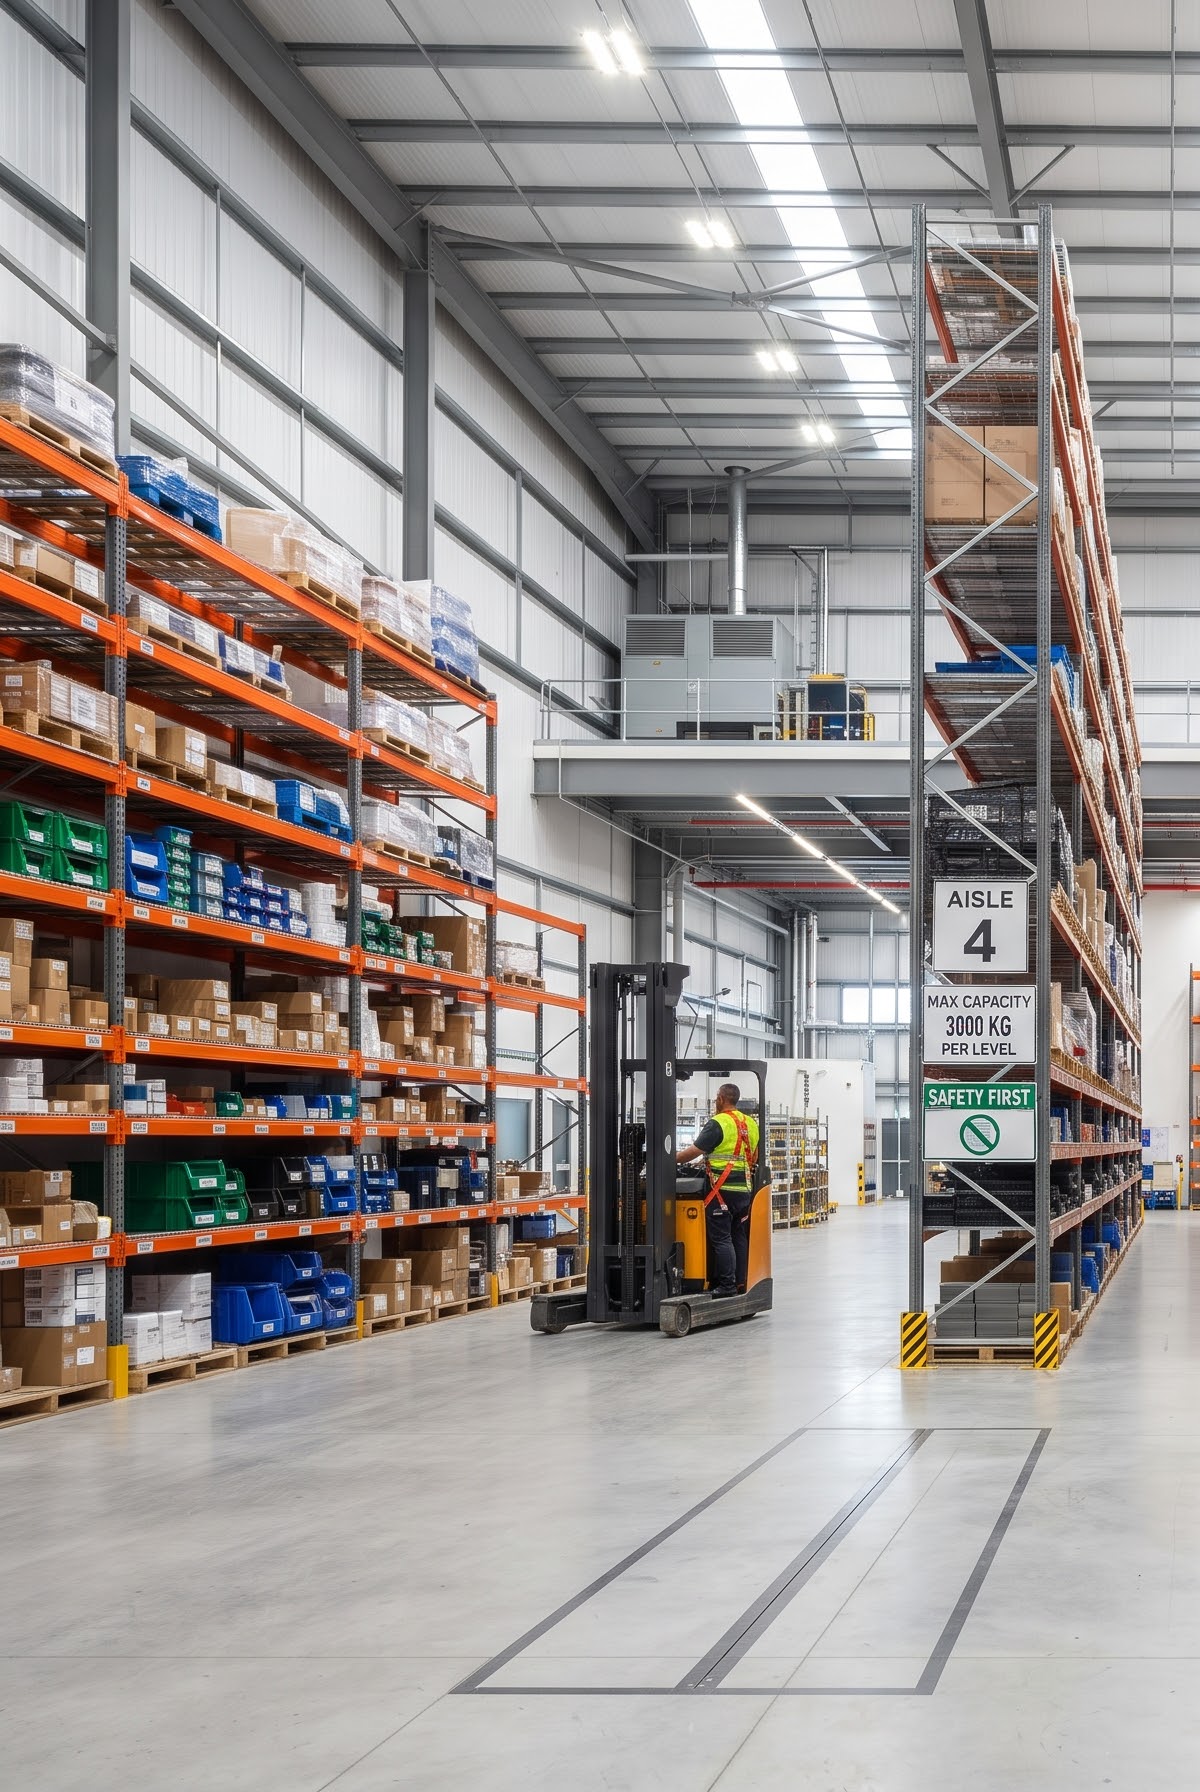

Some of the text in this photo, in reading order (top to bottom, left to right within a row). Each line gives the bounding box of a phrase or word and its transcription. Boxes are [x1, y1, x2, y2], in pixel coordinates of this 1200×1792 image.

[946, 890, 1014, 909] AISLE
[963, 918, 997, 963] 4
[927, 994, 1032, 1009] MAX CAPACITY
[945, 1015, 1012, 1037] 3000 KG
[941, 1042, 1017, 1056] PER LEVEL
[928, 1088, 1031, 1106] SAFETY FIRST
